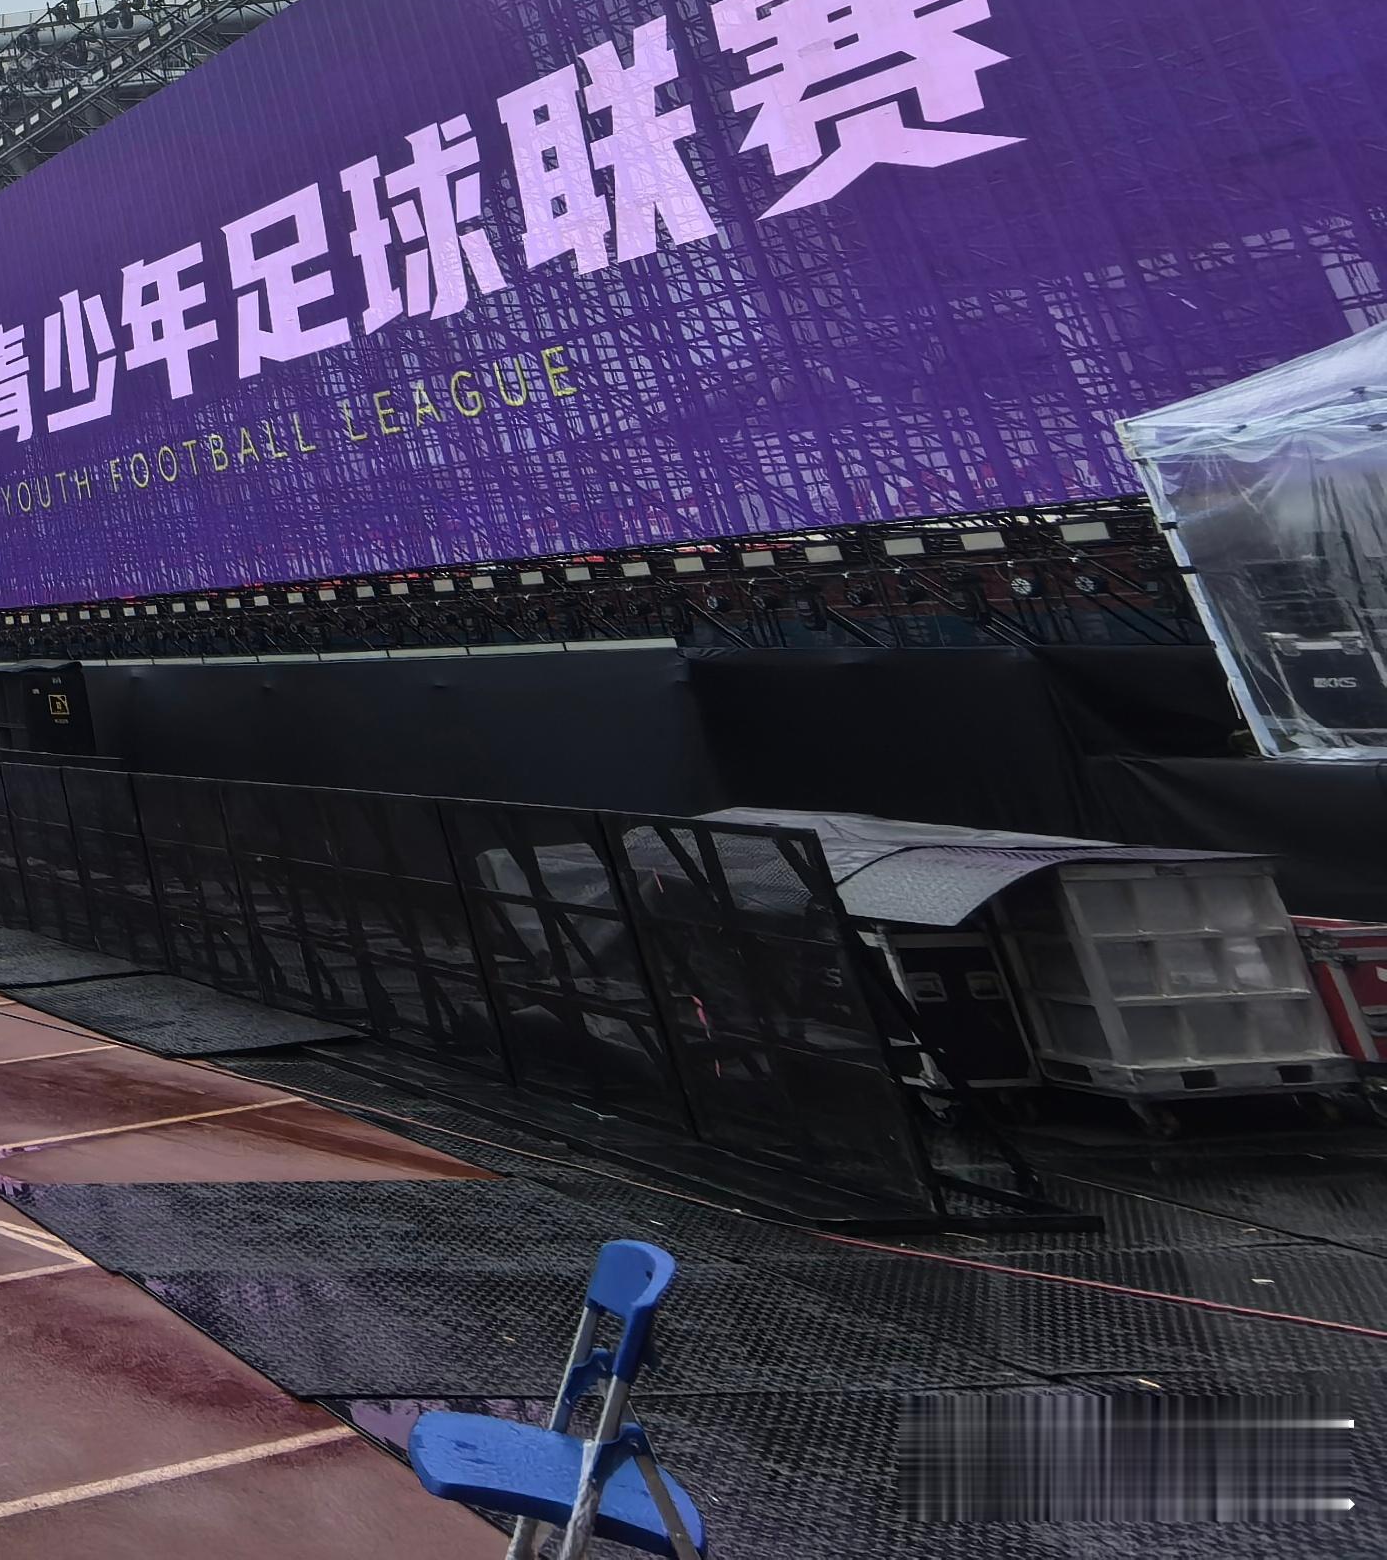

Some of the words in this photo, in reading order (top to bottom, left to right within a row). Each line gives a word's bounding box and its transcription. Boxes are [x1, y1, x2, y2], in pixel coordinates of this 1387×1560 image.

[0, 471, 92, 516] YOUTH
[109, 412, 316, 492] FOOTBALL
[342, 345, 578, 441] LEAGUE
